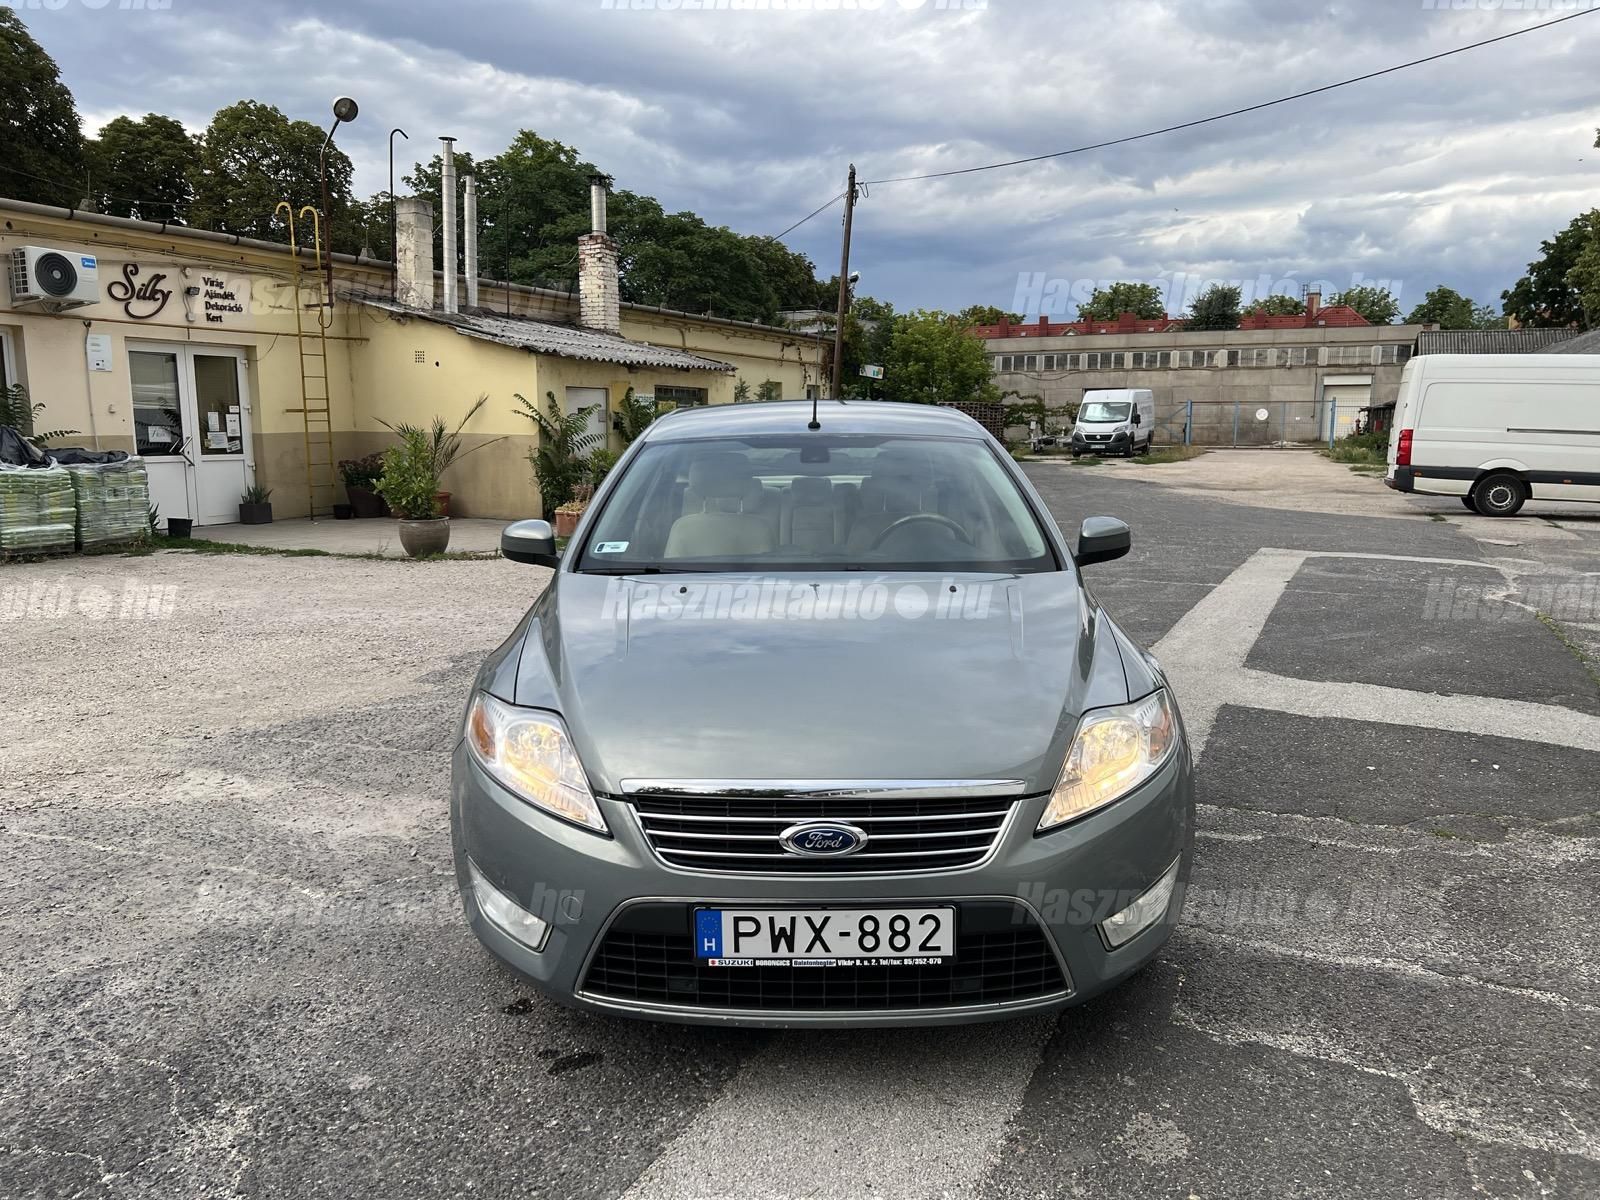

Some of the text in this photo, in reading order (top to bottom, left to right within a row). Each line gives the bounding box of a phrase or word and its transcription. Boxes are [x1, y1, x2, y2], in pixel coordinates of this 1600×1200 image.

[202, 277, 225, 290] Virág
[107, 263, 173, 319] Silky
[204, 289, 236, 301] Ajándék
[205, 301, 243, 313] Dekoráció
[206, 313, 224, 323] Kert
[804, 831, 843, 848] Ford
[732, 914, 942, 953] PWX-882
[704, 937, 716, 952] H
